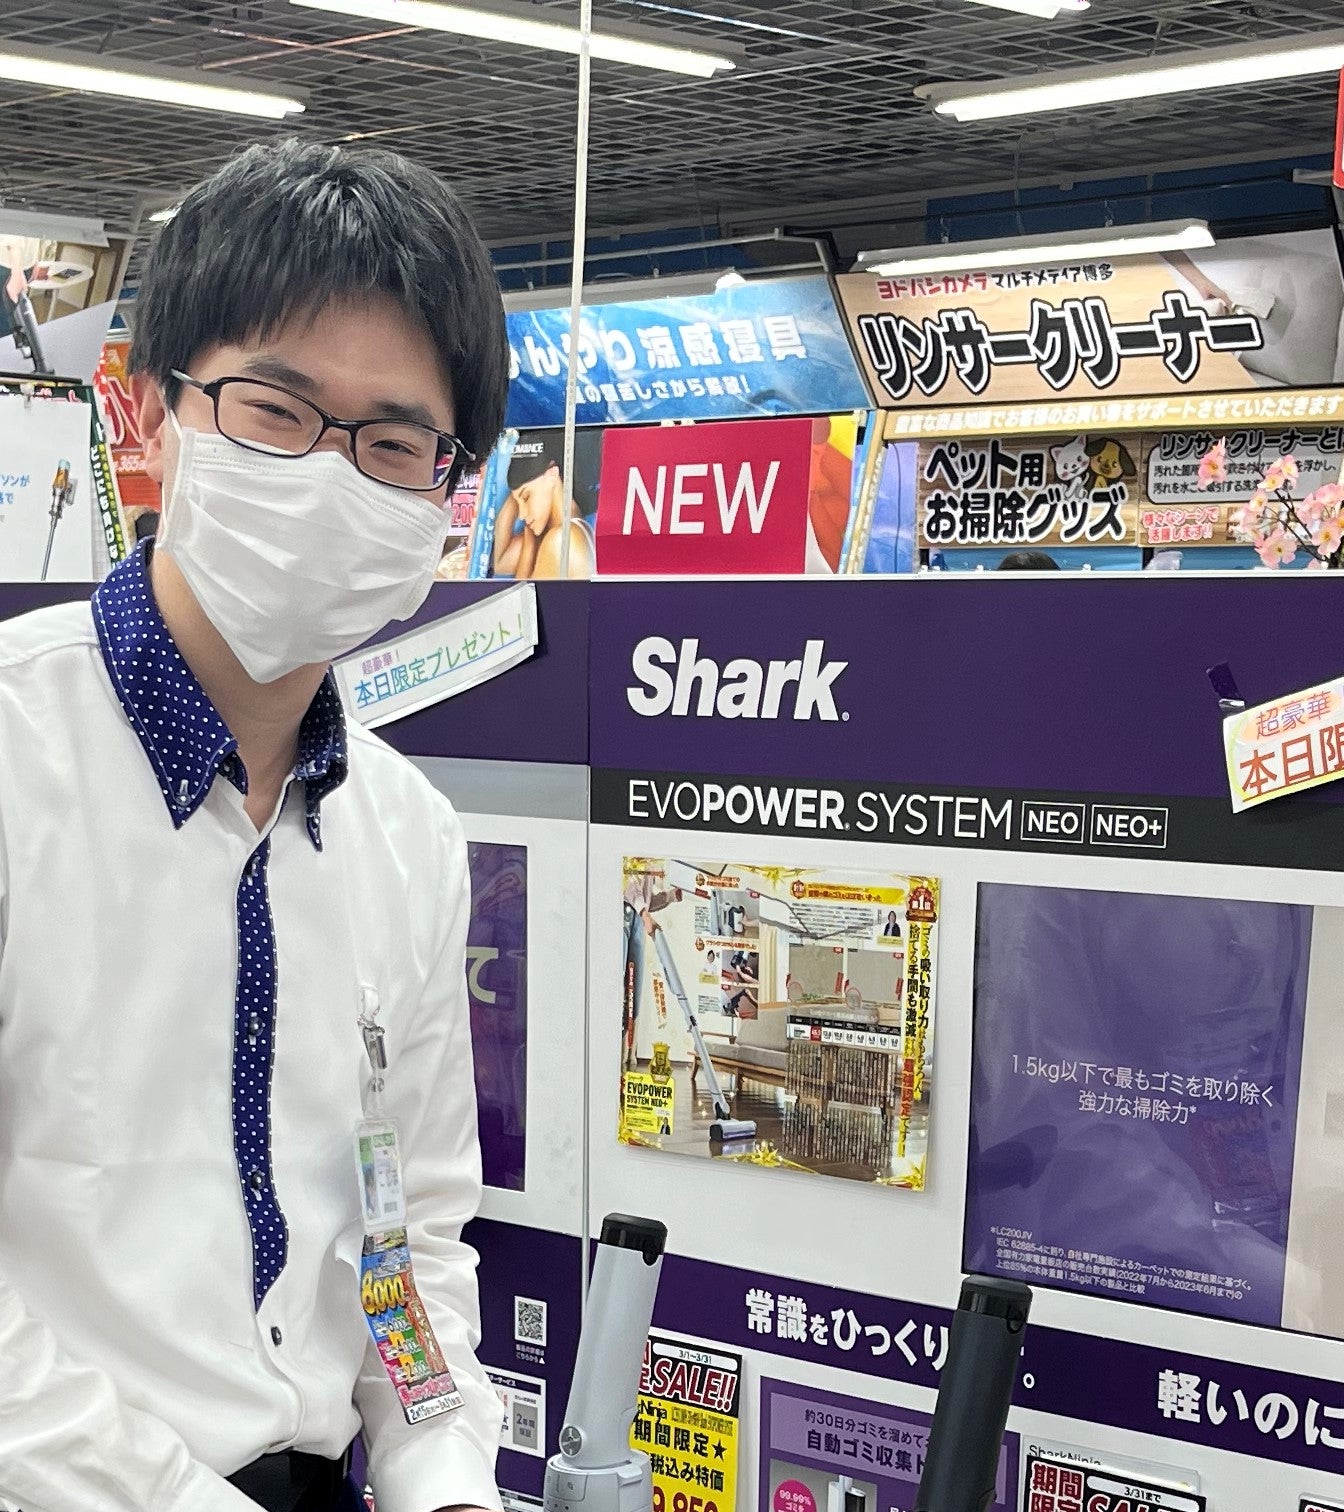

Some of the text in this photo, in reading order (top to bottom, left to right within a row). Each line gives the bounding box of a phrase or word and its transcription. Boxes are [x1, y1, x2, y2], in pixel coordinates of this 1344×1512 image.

[877, 263, 1115, 299] ヨドバシカメラ マルチメディア博多
[861, 290, 1264, 400] リンサークリーナー
[926, 434, 1046, 486] ペット用
[622, 460, 781, 537] NEW
[924, 484, 1129, 544] お掃除グッズ
[353, 613, 525, 708] 本日限定プレゼント!
[627, 635, 851, 723] Shark
[627, 779, 1163, 841] EVOPOWER SYSTEM NEO NEO+
[1010, 1052, 1275, 1108] 1.5kg以下で最もゴミを取り除く
[652, 1355, 737, 1413] SALE!!
[1030, 1463, 1084, 1503] 期間
[1124, 1485, 1162, 1504] 3/31まで
